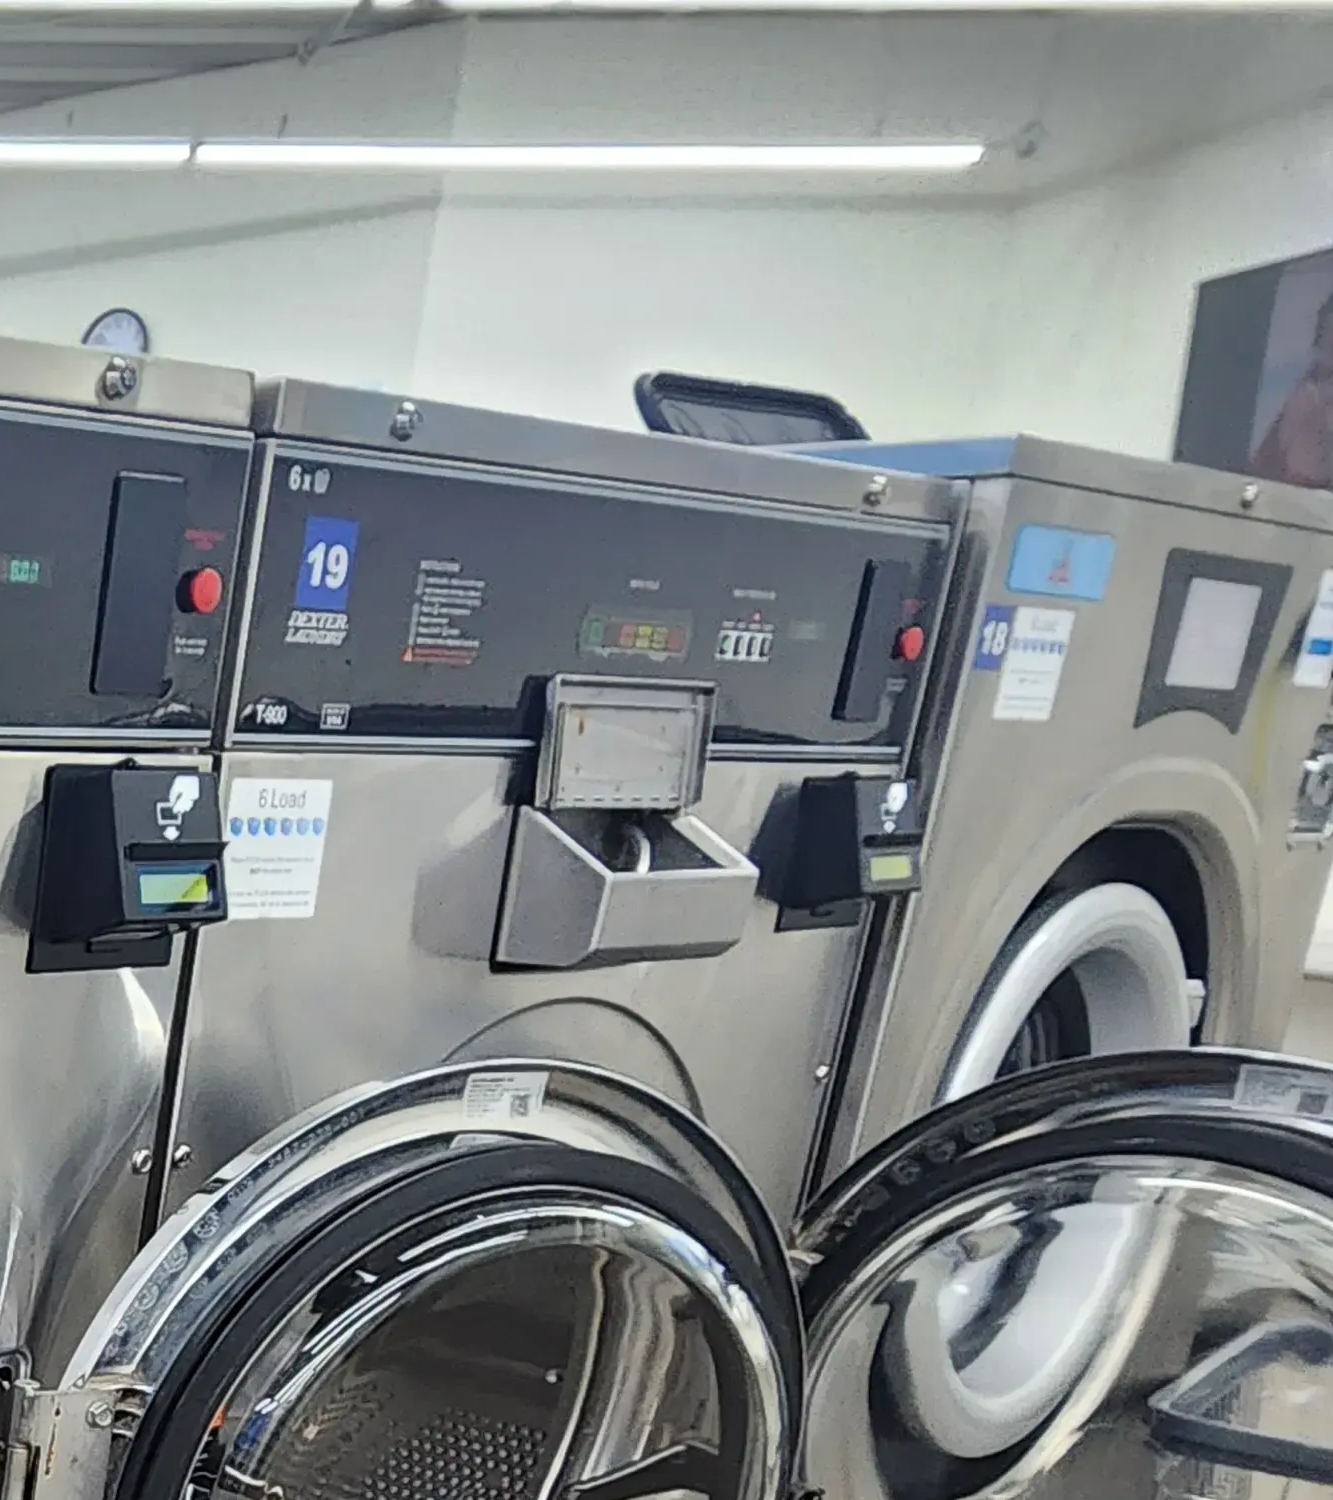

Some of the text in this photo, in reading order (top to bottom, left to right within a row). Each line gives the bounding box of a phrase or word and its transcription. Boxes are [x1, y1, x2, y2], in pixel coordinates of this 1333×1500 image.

[288, 464, 301, 491] 6
[307, 541, 349, 590] 19
[980, 619, 1009, 656] 18
[258, 788, 307, 809] 6 Load
